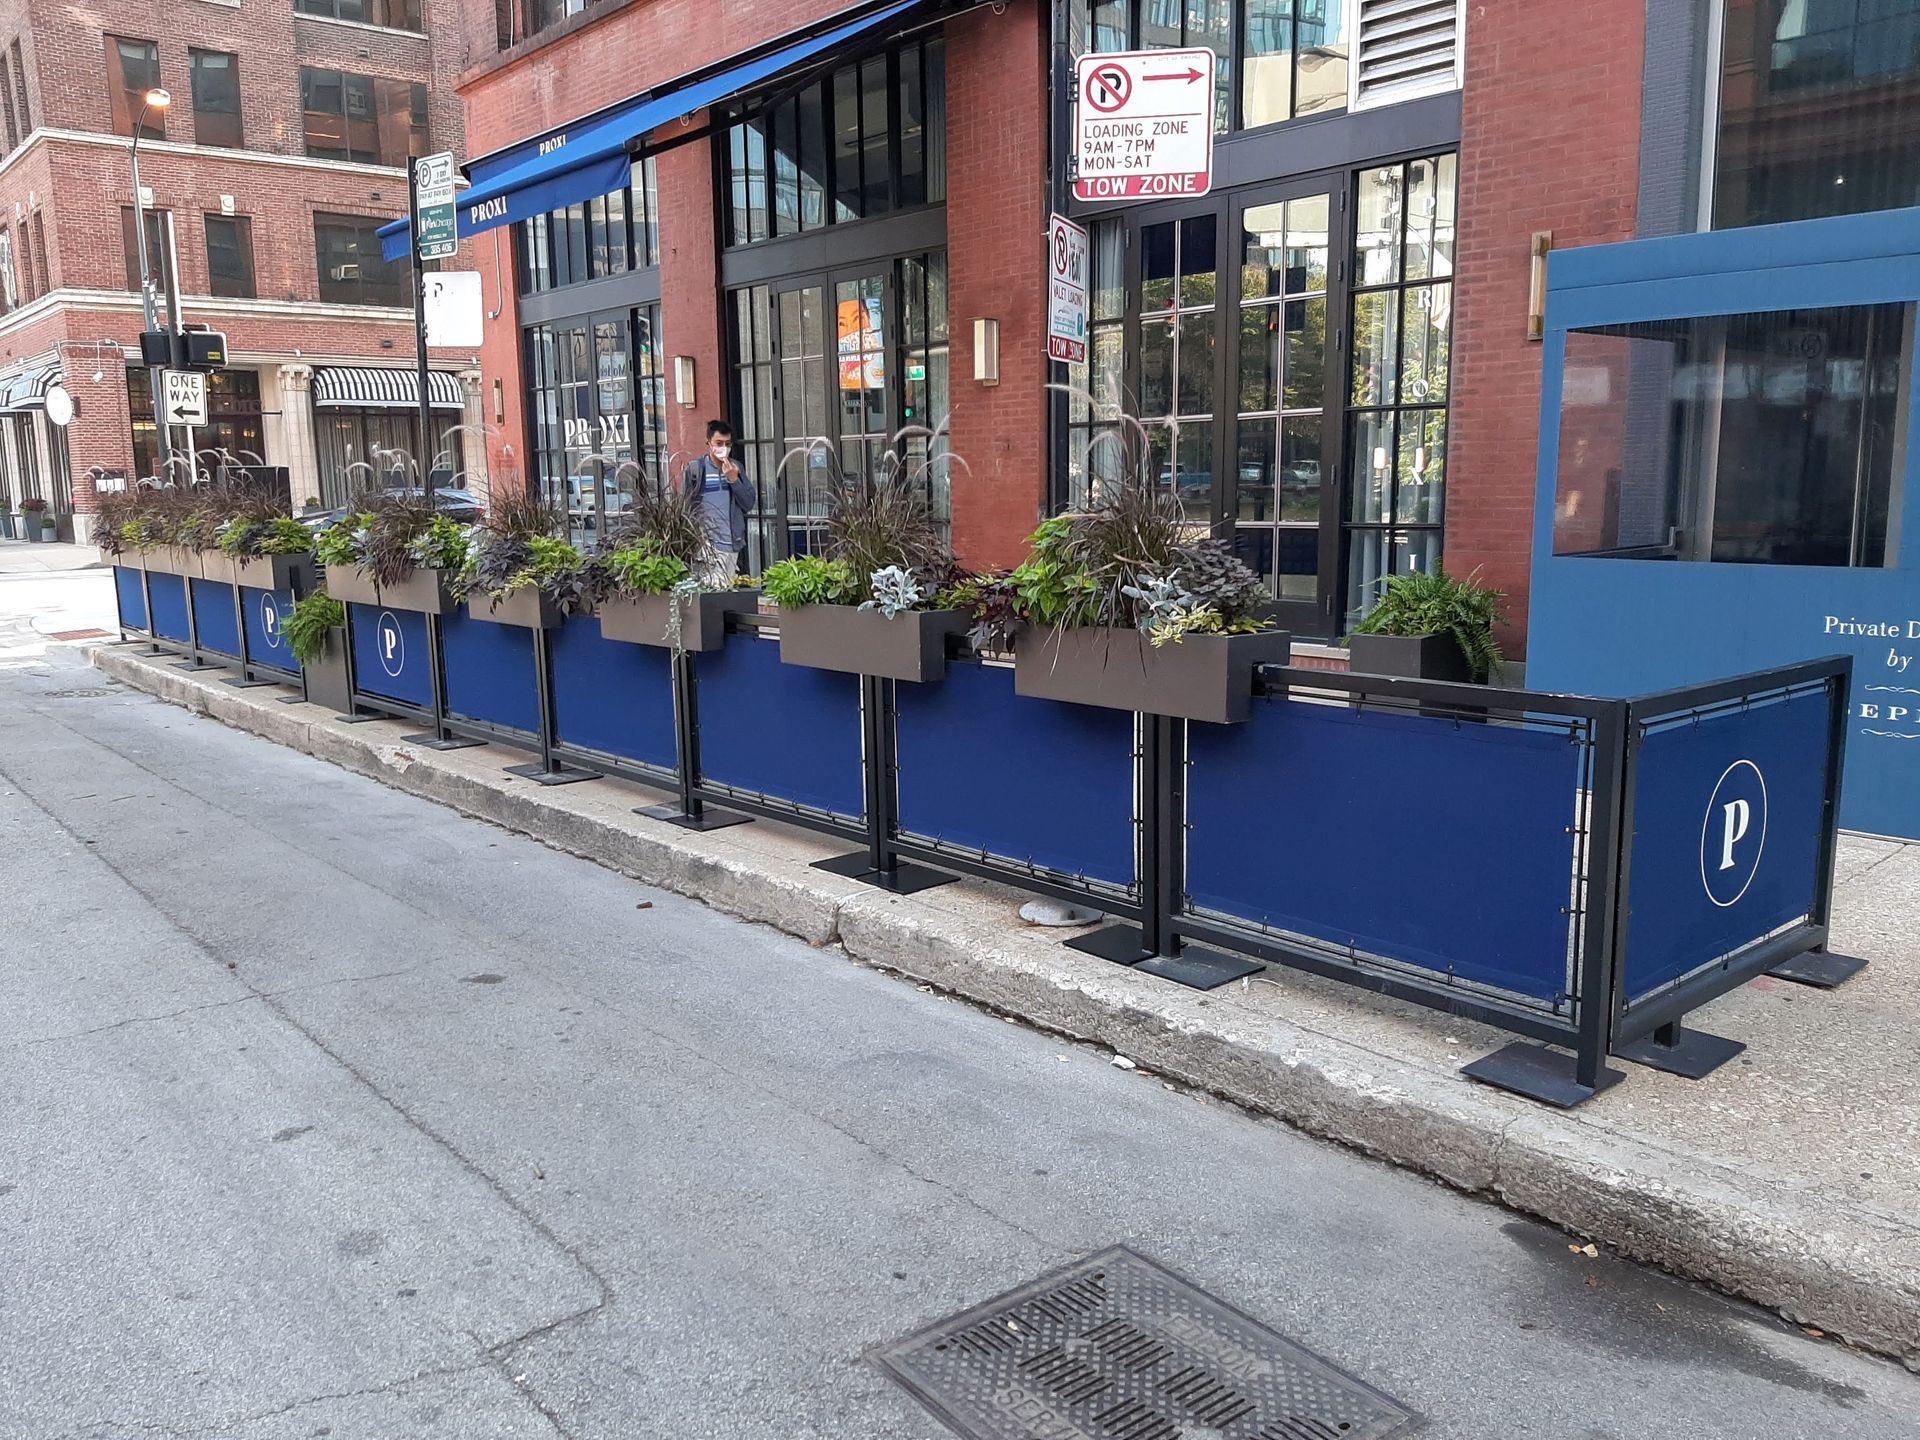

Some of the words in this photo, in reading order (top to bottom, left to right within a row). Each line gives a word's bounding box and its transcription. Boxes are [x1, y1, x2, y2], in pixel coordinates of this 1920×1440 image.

[1084, 123, 1144, 139] LOADING
[1152, 121, 1189, 136] ZONE
[539, 134, 567, 156] PROXI
[1084, 154, 1152, 170] MON-SAT
[1083, 176, 1128, 197] TOW
[1139, 173, 1197, 194] ZONE
[470, 195, 508, 225] PROXI
[1052, 337, 1067, 357] TOW
[170, 375, 199, 389] ONE
[170, 389, 200, 403] WAY
[265, 607, 274, 633] P
[1823, 615, 1900, 638] Private
[384, 628, 396, 659] P
[1887, 647, 1913, 673] by
[1719, 799, 1750, 871] P
